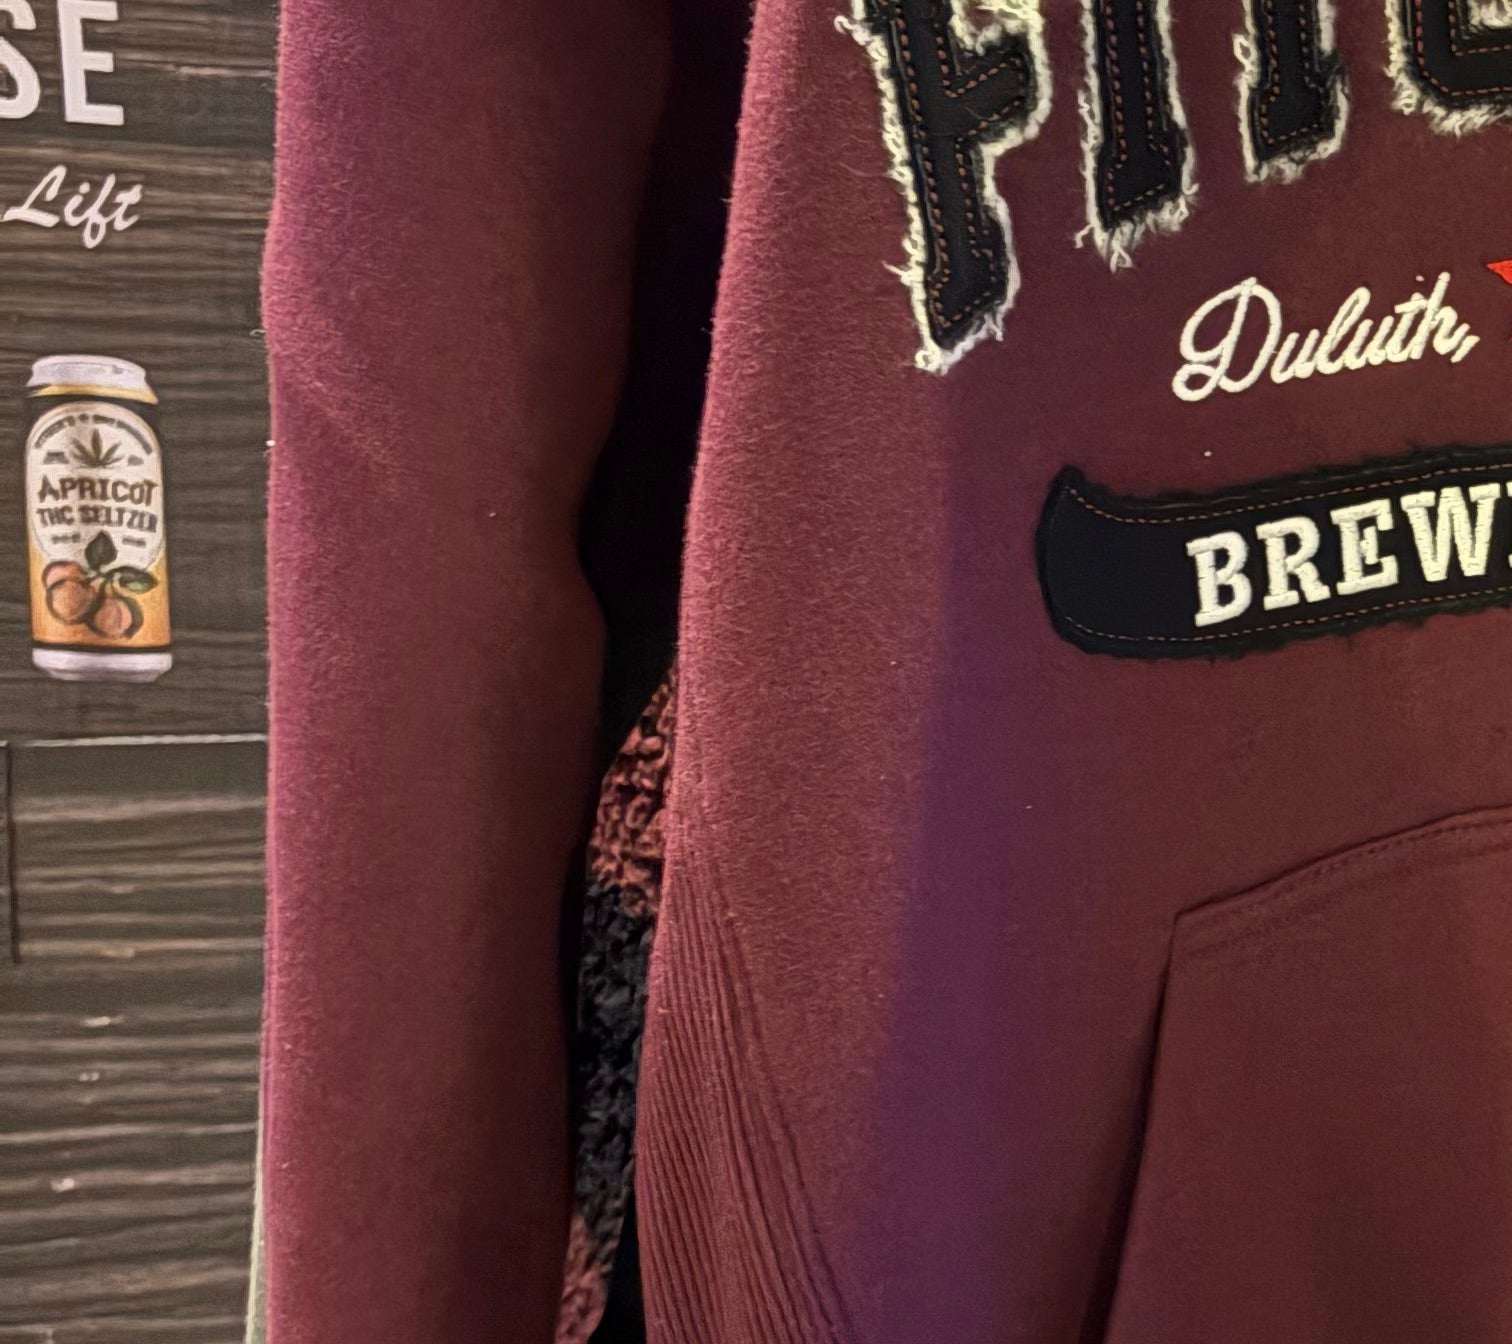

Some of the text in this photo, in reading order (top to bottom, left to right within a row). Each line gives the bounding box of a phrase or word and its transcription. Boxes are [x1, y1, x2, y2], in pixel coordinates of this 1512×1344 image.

[2, 164, 143, 249] Lift
[1171, 271, 1481, 402] Duluth,
[36, 505, 75, 528] THC
[38, 474, 158, 508] APRICOT
